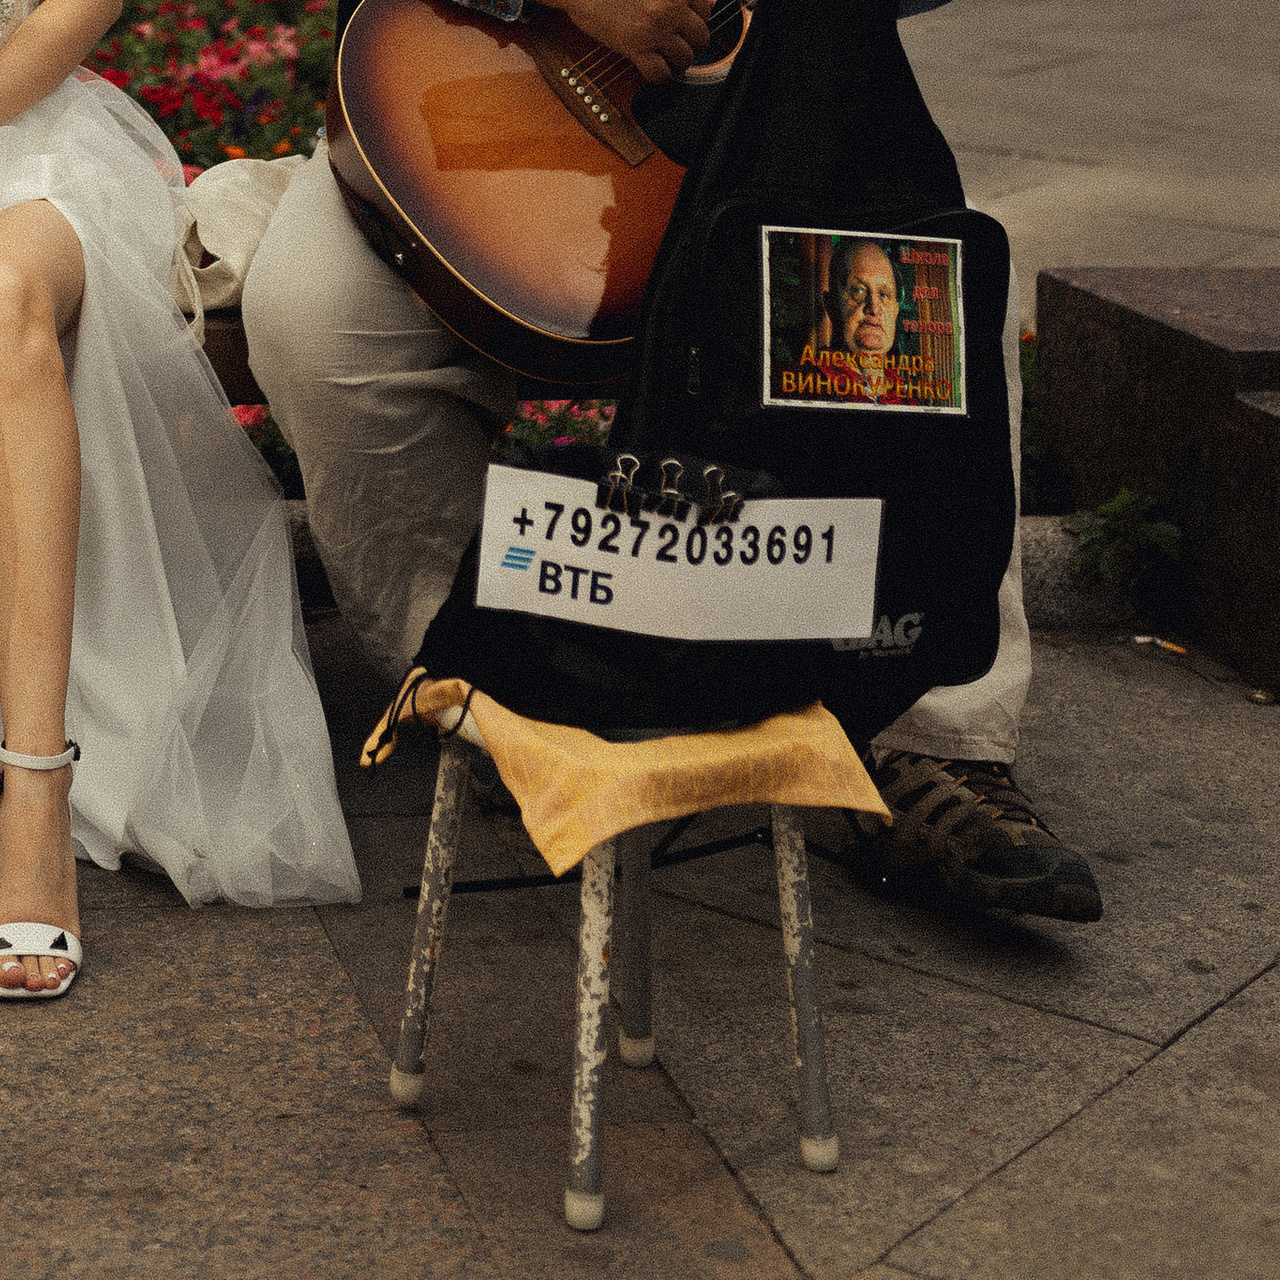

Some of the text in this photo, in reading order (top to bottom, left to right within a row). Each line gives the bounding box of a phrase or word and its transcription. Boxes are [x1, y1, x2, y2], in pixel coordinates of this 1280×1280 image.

[900, 247, 949, 266] Школа
[912, 286, 939, 301] для
[903, 319, 953, 336] тенора
[799, 344, 935, 377] Александра
[782, 371, 952, 400] ВИНОКУРЕНКО
[512, 501, 835, 566] +79272033691
[537, 560, 615, 606] ВТБ
